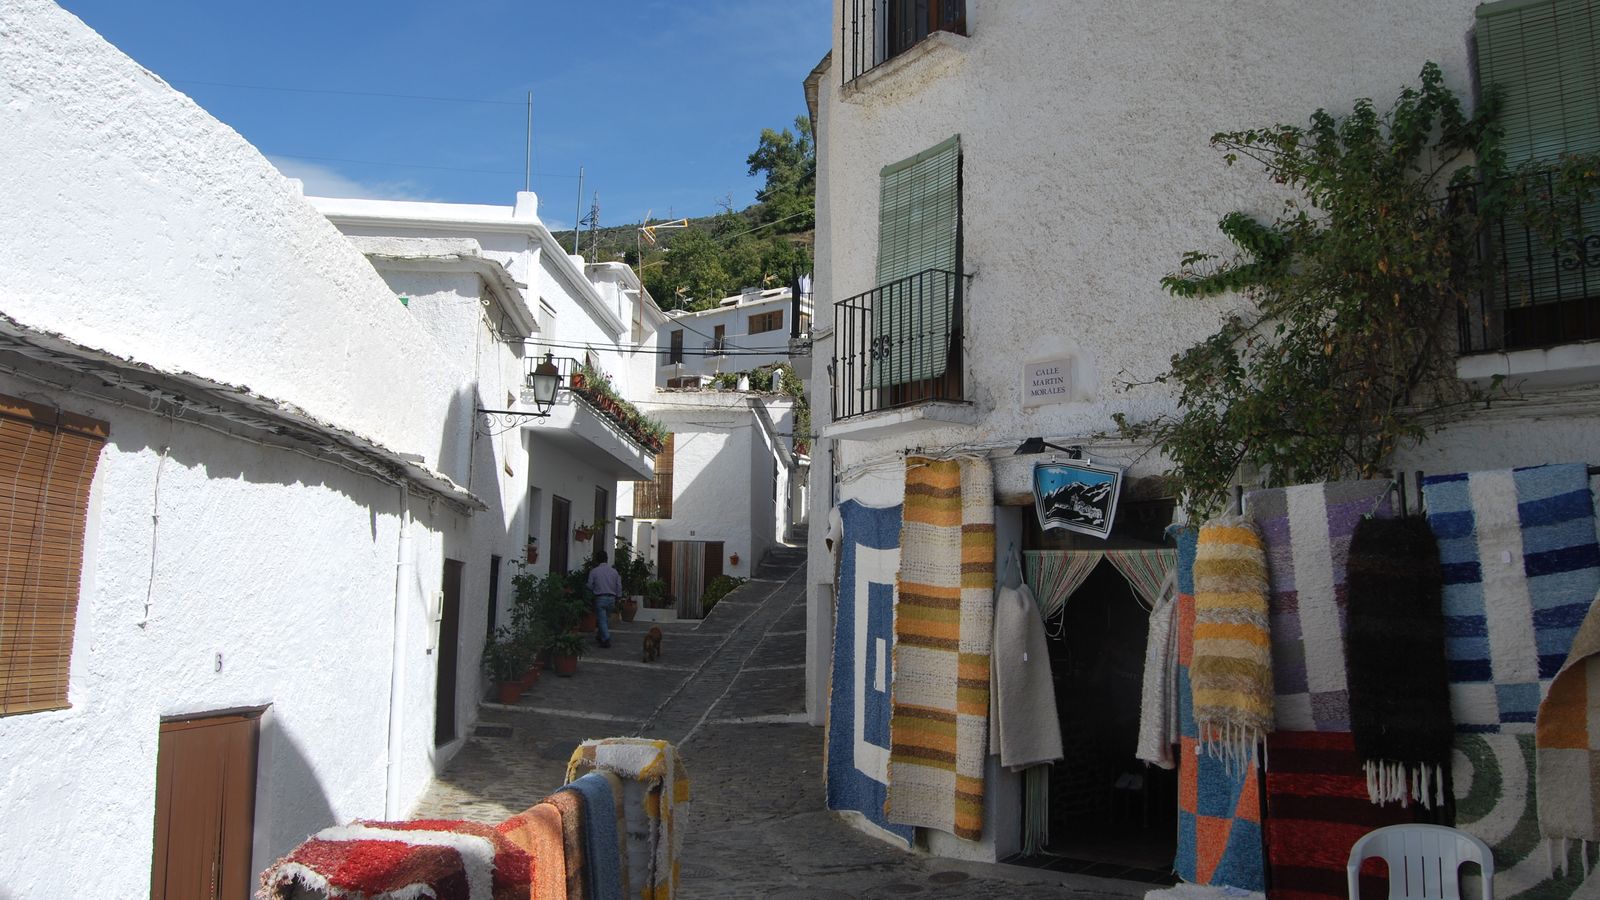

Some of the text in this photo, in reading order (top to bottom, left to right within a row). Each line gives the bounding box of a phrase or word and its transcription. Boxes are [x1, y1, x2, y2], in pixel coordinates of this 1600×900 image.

[1035, 367, 1060, 376] CALLE
[1032, 376, 1064, 386] MARTIN
[1031, 386, 1066, 396] MORALES
